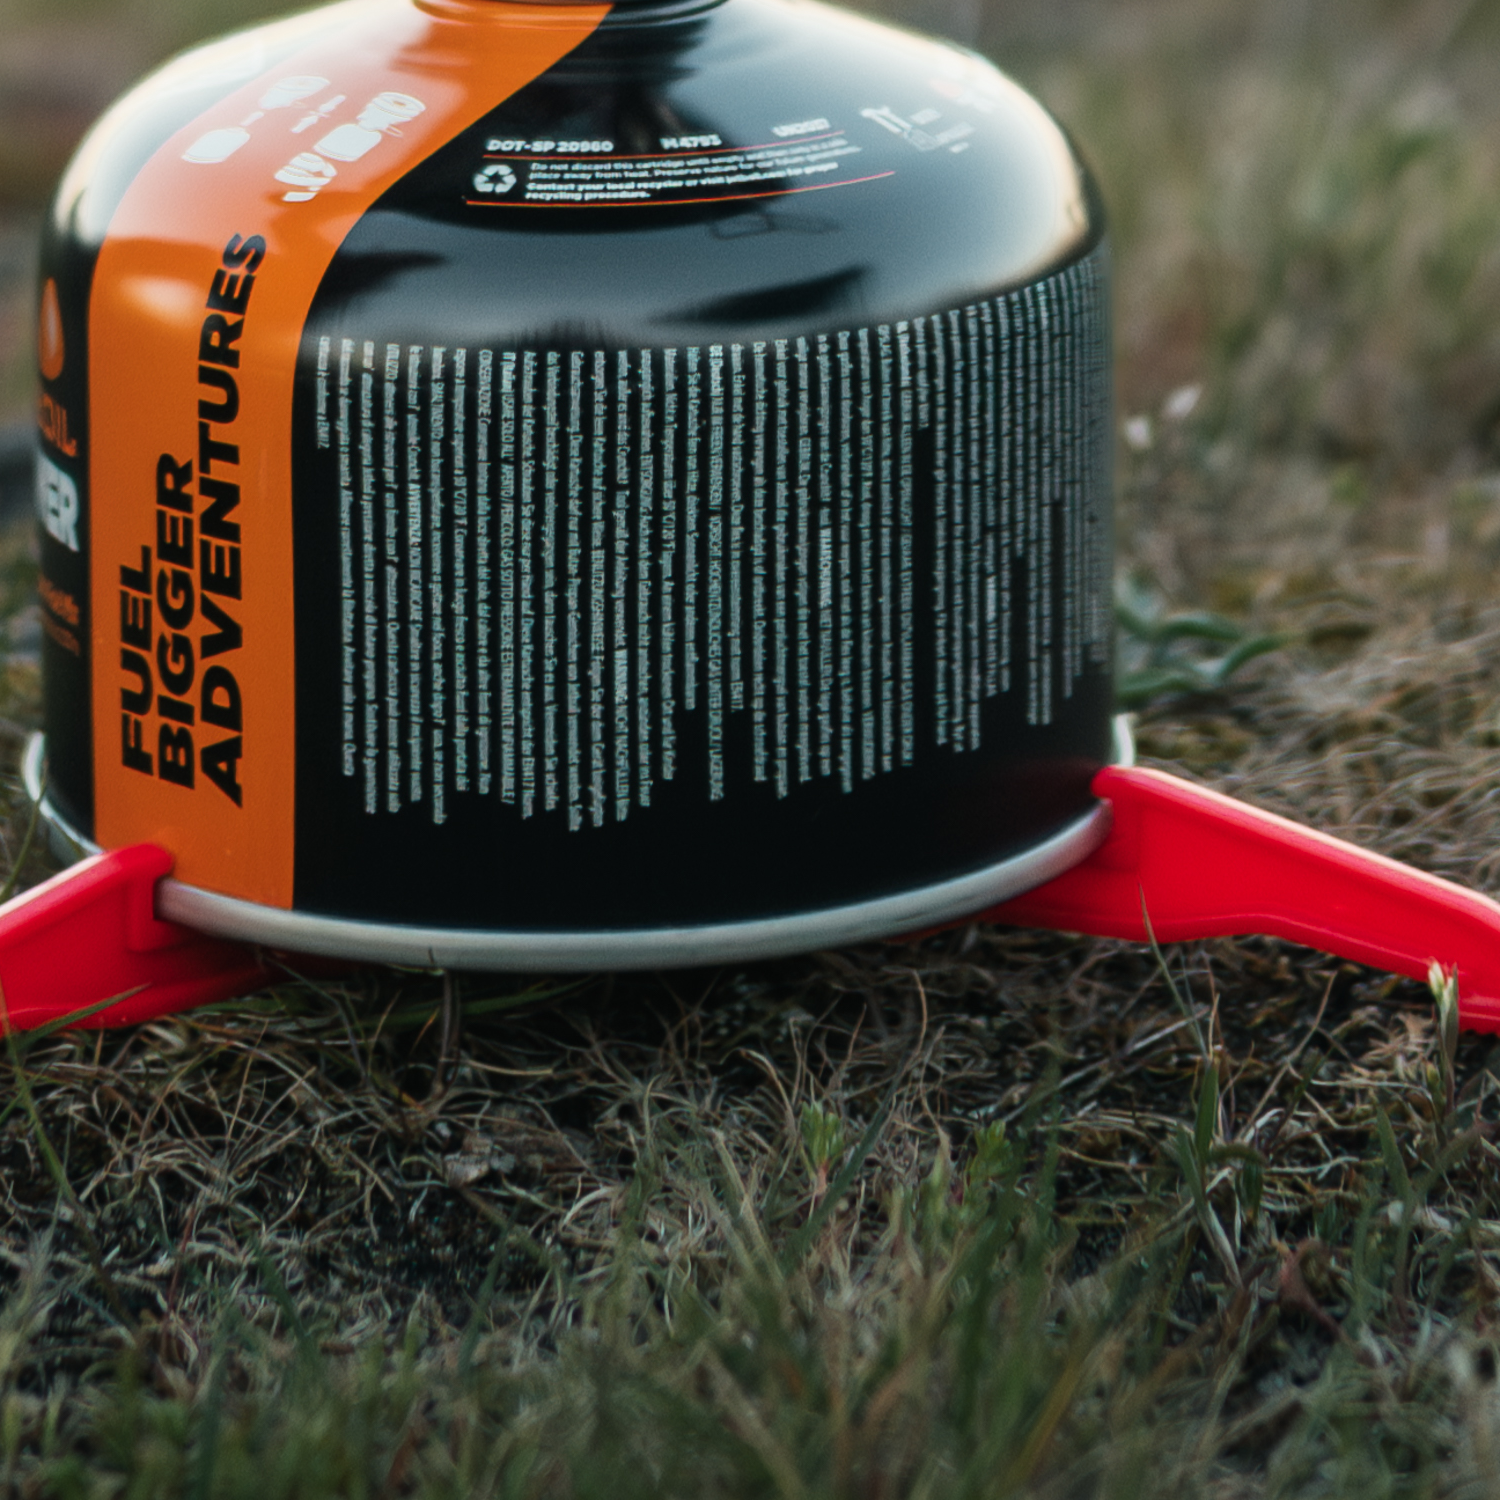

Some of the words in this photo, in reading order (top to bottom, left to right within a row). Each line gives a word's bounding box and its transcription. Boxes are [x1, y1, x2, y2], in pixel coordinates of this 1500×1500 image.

[487, 139, 555, 152] DOT-SP
[525, 191, 583, 201] recycling
[526, 181, 576, 191] Contact
[577, 183, 605, 192] your
[606, 181, 635, 190] local
[197, 233, 267, 808] ADVENTURES
[120, 544, 153, 776] FUEL
[156, 453, 195, 790] BIGGER
